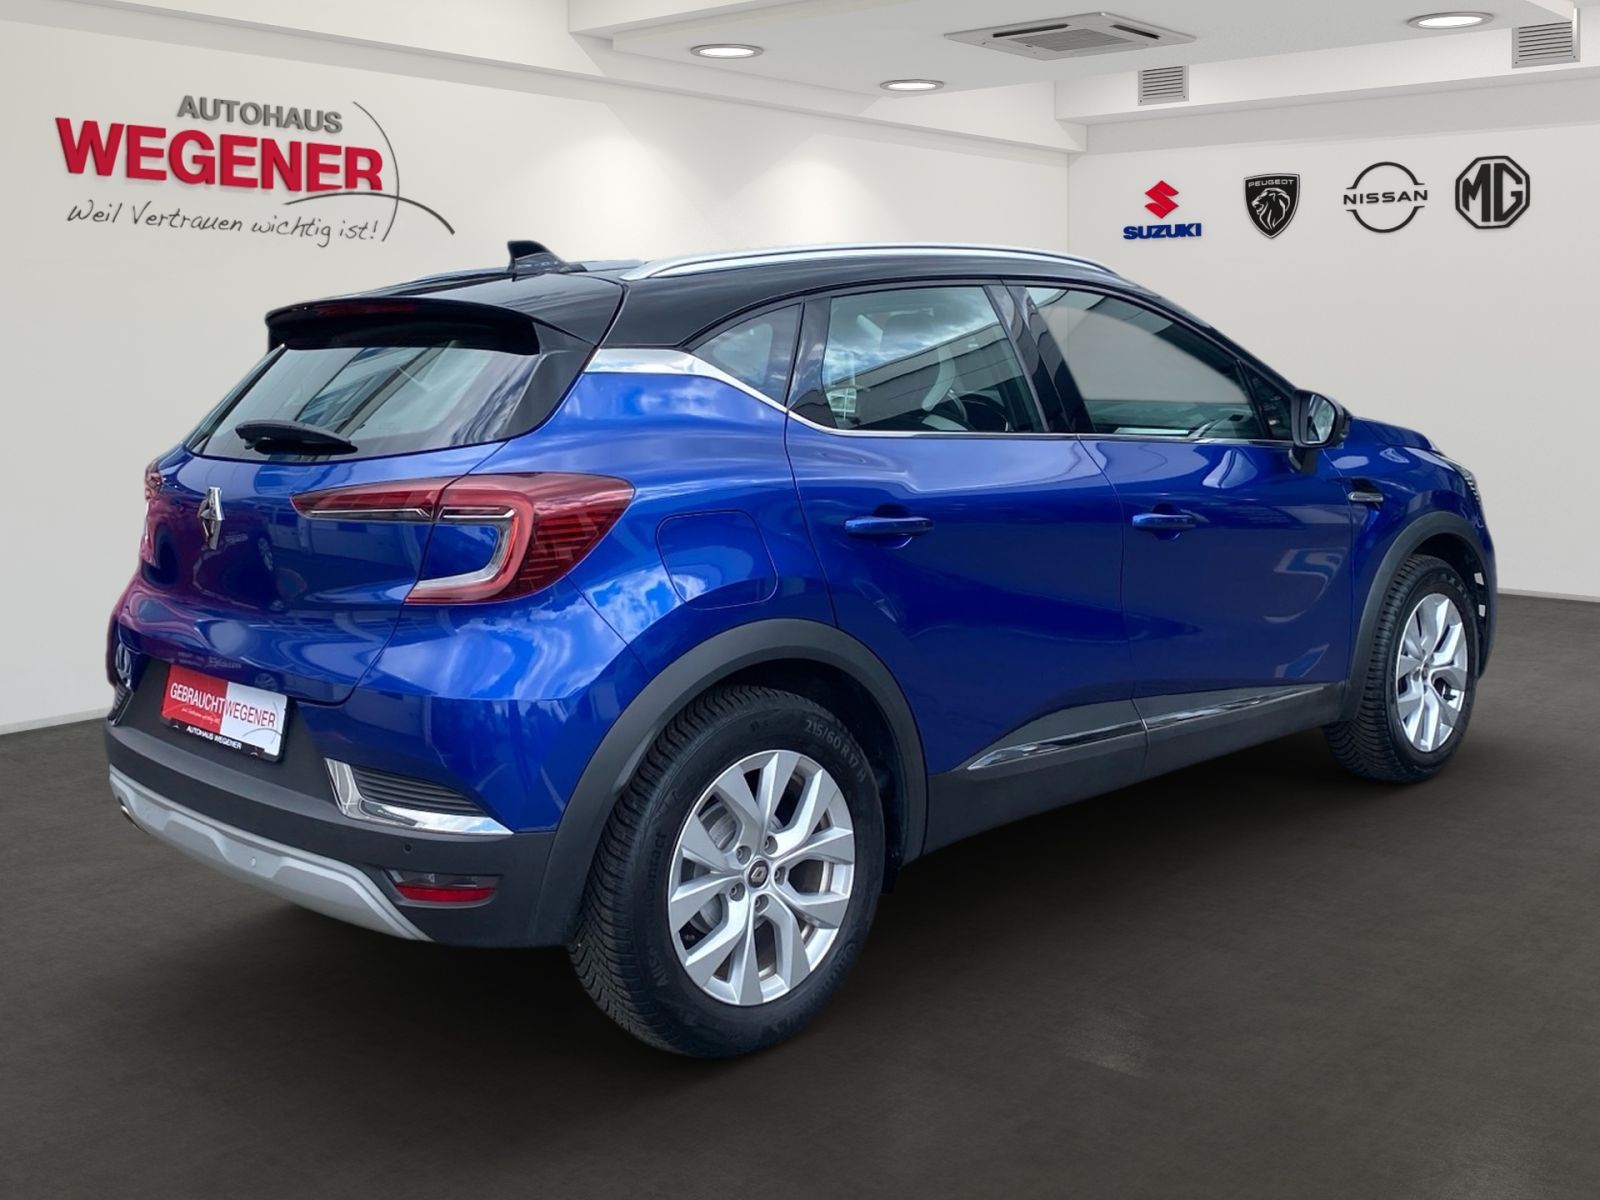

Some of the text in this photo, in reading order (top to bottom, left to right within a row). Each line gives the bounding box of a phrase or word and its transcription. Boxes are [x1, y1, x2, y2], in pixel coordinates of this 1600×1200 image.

[177, 95, 343, 133] AUTOHAUS
[55, 117, 384, 193] WEGENER
[1248, 178, 1295, 188] PEUGEOT
[1343, 189, 1429, 206] NISSAN
[1462, 163, 1523, 223] MG
[67, 200, 380, 249] Weil Vertrauen wichtig ist!
[1123, 222, 1203, 240] SUZUKI
[185, 725, 243, 750] AUTOHAUS WEGENER
[804, 718, 843, 750] 215/60
